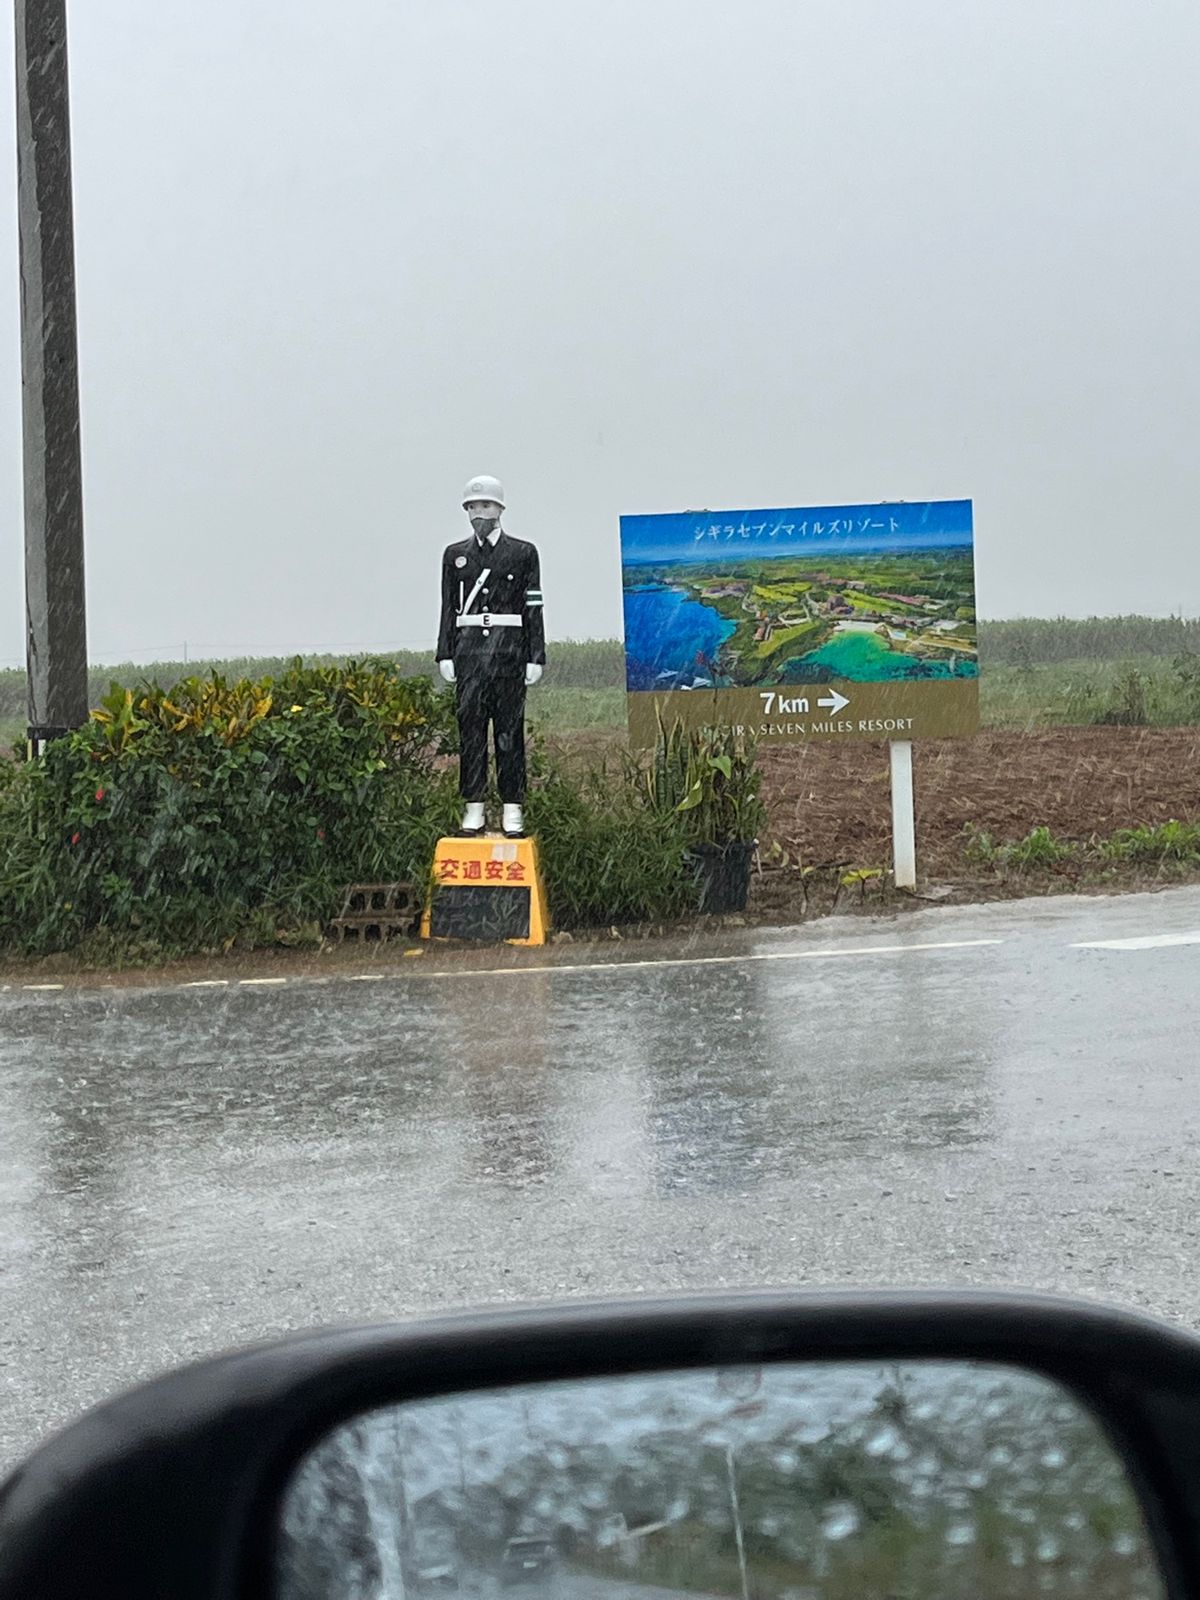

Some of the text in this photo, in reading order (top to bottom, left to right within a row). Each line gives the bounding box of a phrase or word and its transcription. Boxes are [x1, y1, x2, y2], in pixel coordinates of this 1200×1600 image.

[693, 517, 899, 540] シギラセブンマイルズリゾート
[760, 723, 805, 735] SEVEN
[811, 721, 853, 732] MILES
[858, 718, 914, 731] RESORT
[440, 859, 525, 881] 交通安全
